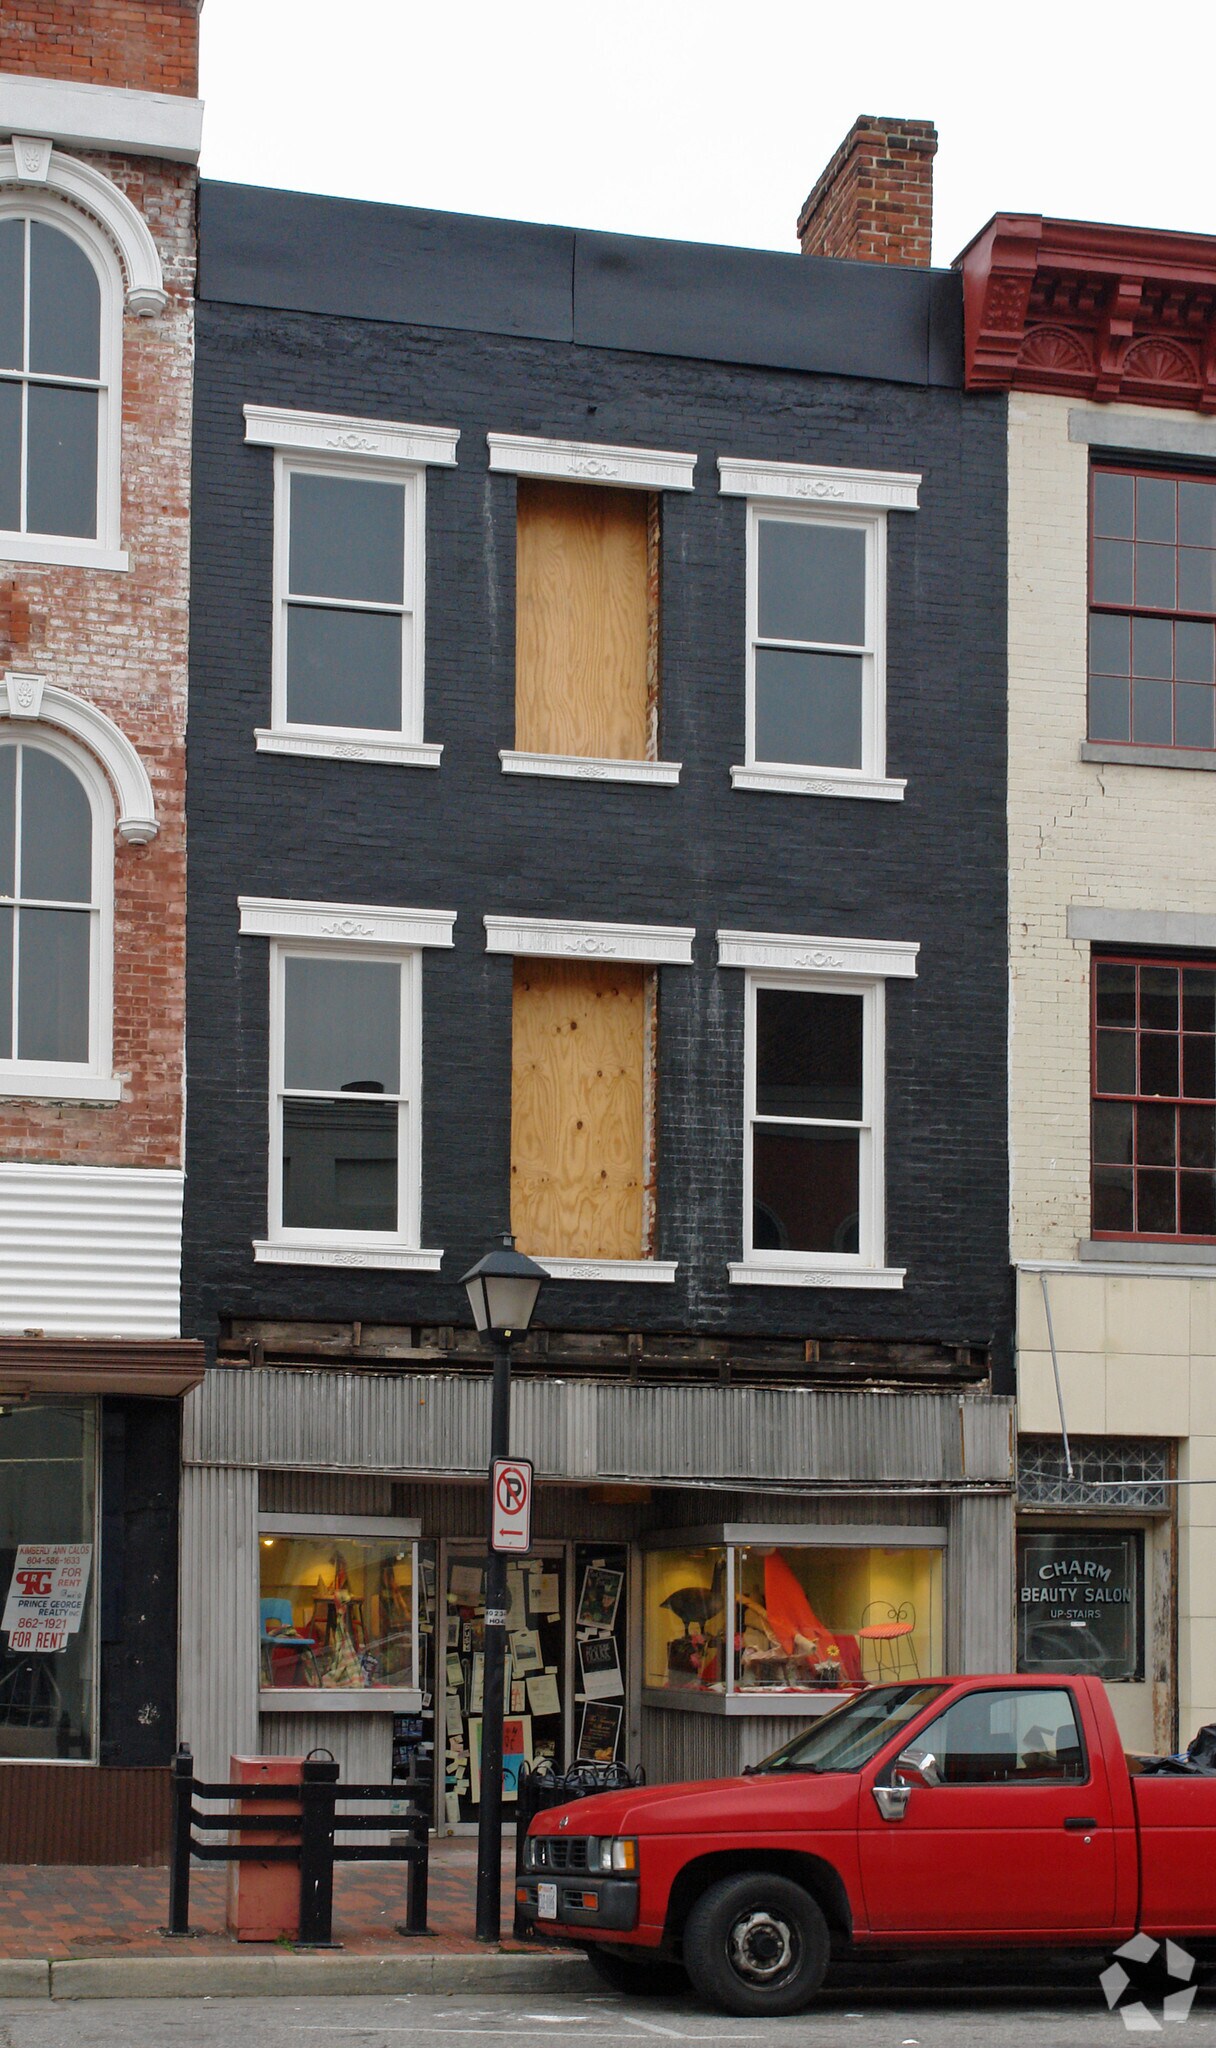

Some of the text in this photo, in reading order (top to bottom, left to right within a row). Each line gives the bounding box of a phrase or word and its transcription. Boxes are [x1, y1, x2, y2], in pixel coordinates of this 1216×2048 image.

[20, 1546, 90, 1555] KIMBERLY ANN CALOS
[61, 1567, 82, 1577] FOR
[1038, 1560, 1112, 1583] CHARM
[57, 1579, 82, 1587] RENT
[1020, 1587, 1132, 1603] BEAUTY SALON
[18, 1600, 81, 1609] PRINCE GEORGE
[38, 1608, 69, 1616] REALTY
[18, 1617, 67, 1629] 862-1921
[11, 1631, 65, 1649] FOR RENT
